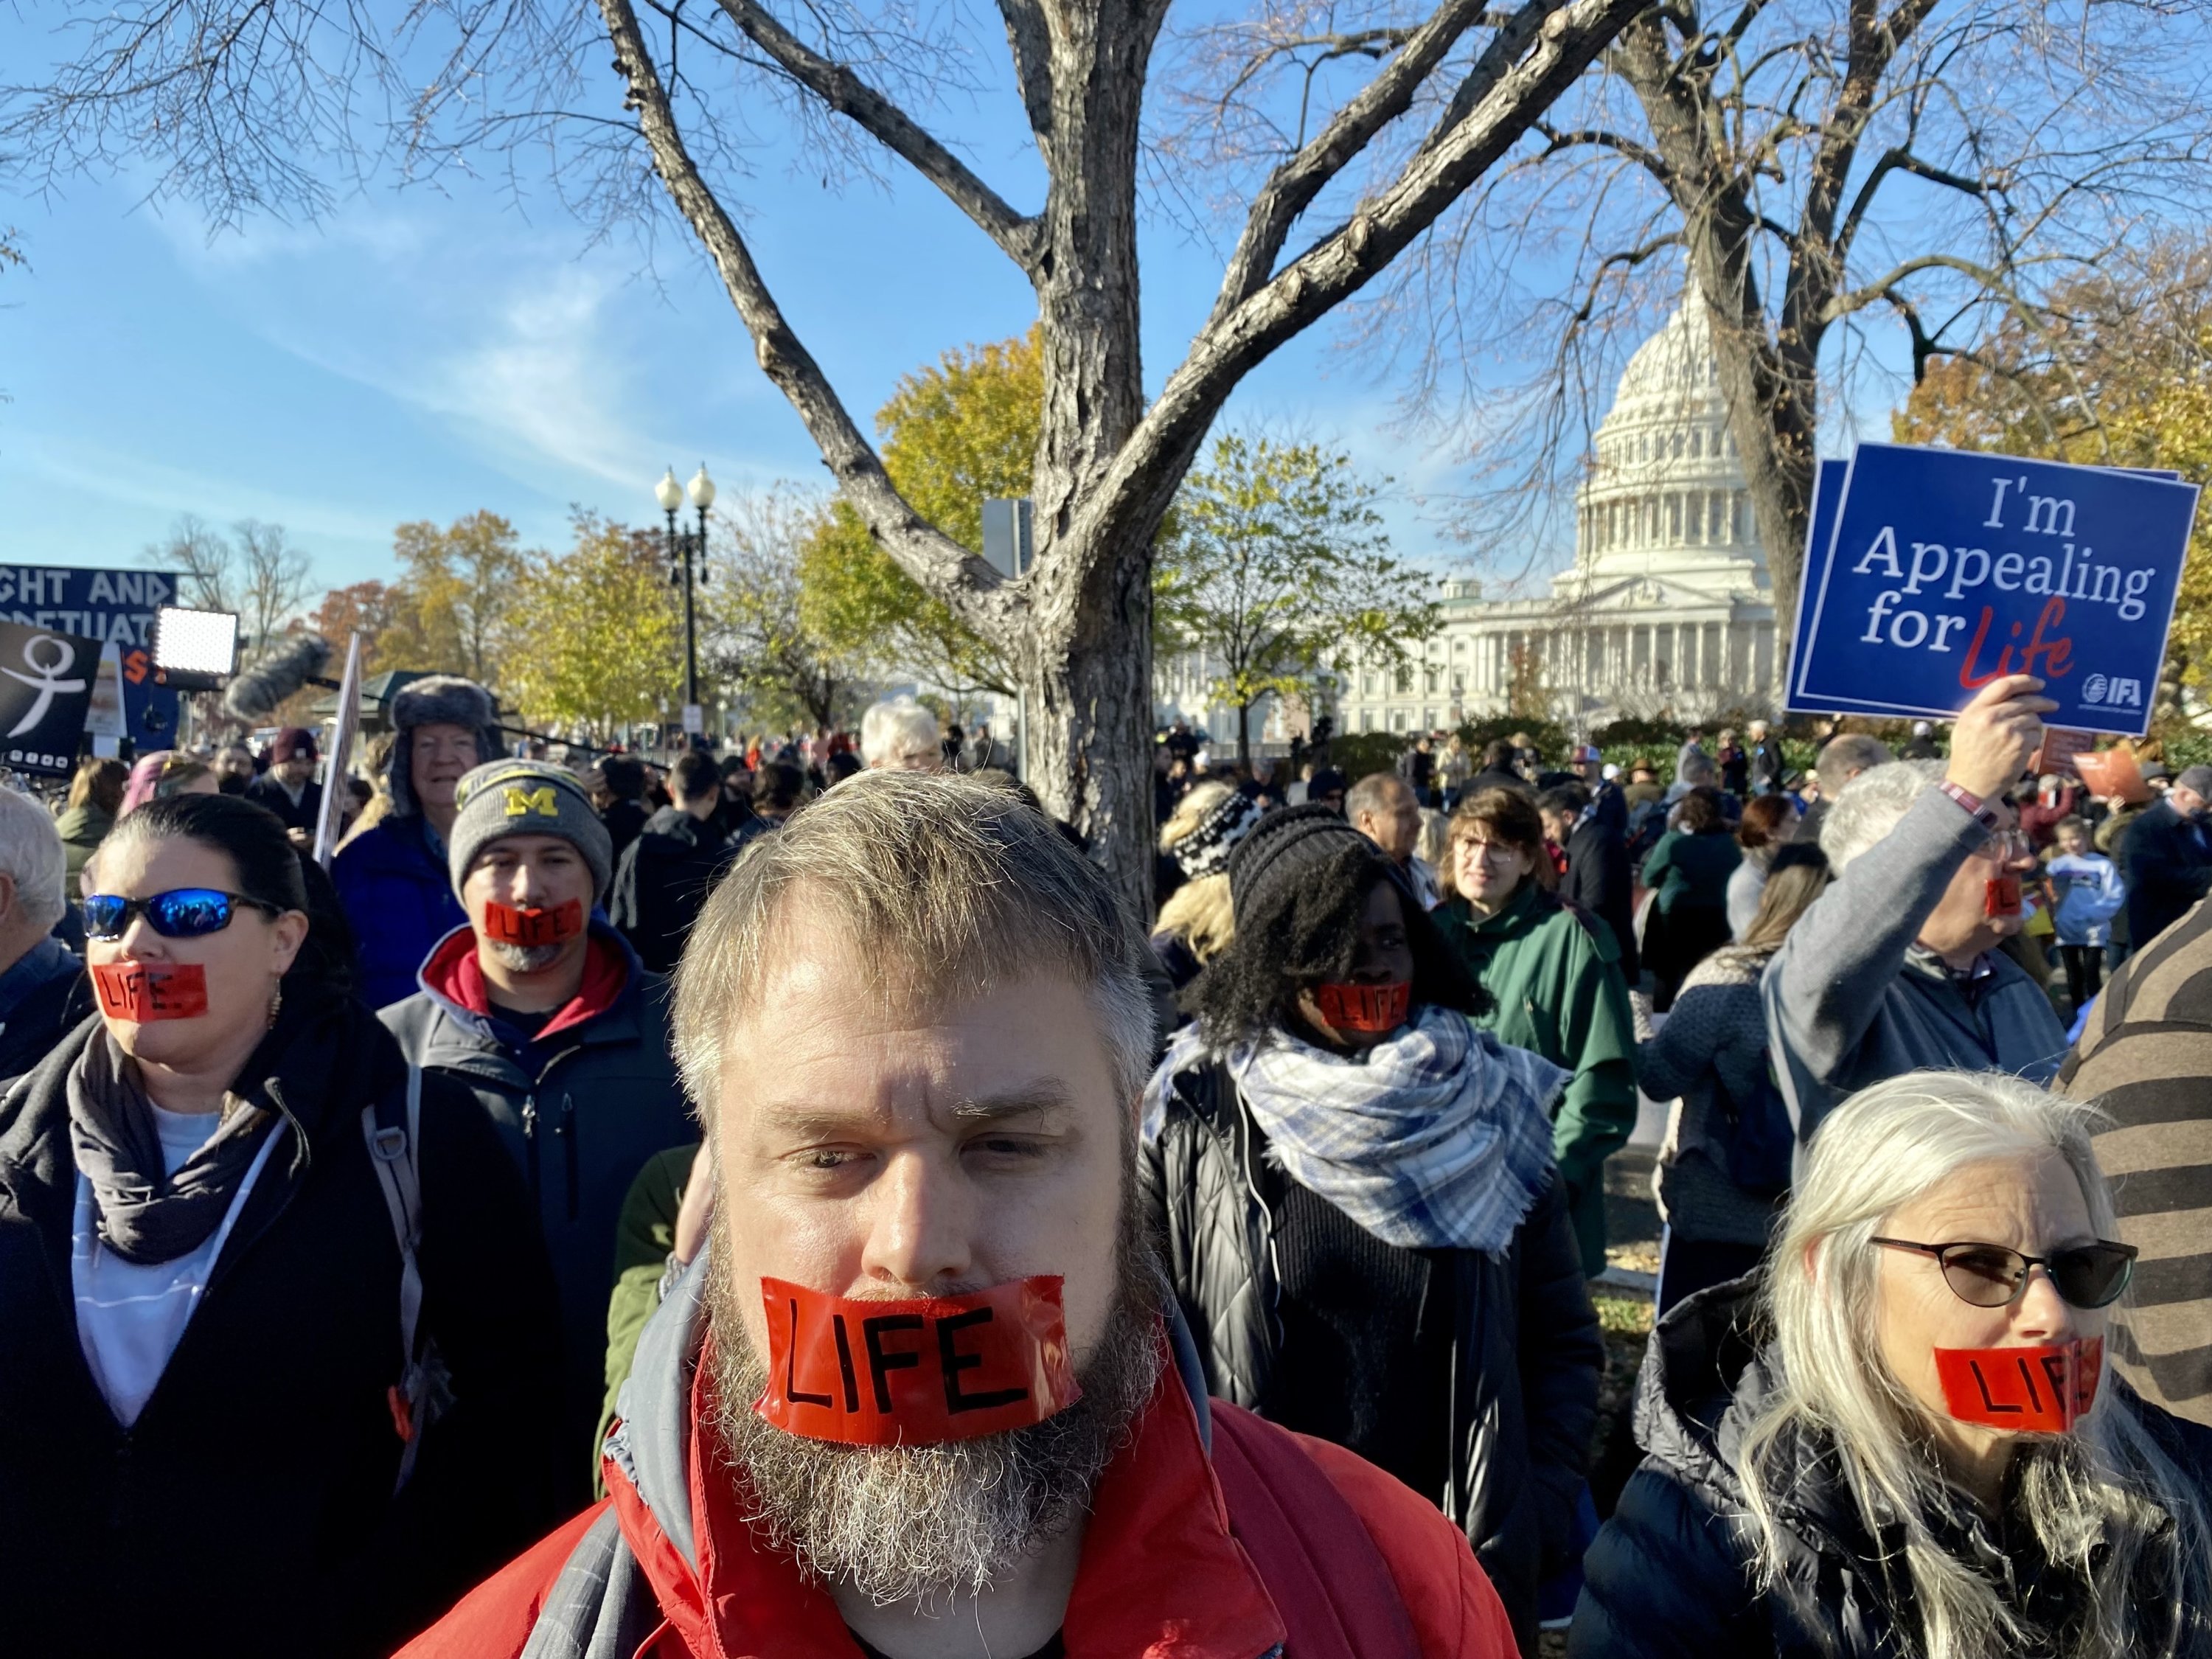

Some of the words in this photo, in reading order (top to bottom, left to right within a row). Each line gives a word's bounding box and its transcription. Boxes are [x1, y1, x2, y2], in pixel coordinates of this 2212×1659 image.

[1983, 476, 2076, 538] I'm
[88, 571, 170, 608] AND
[1852, 526, 2156, 621] Appealing
[1860, 589, 1966, 653] for
[1959, 596, 2075, 689] Life
[2106, 677, 2141, 706] IFA
[504, 786, 558, 816] M
[500, 907, 570, 940] LIFE
[100, 971, 183, 1010] LIFE
[786, 1298, 1029, 1415] LIFE
